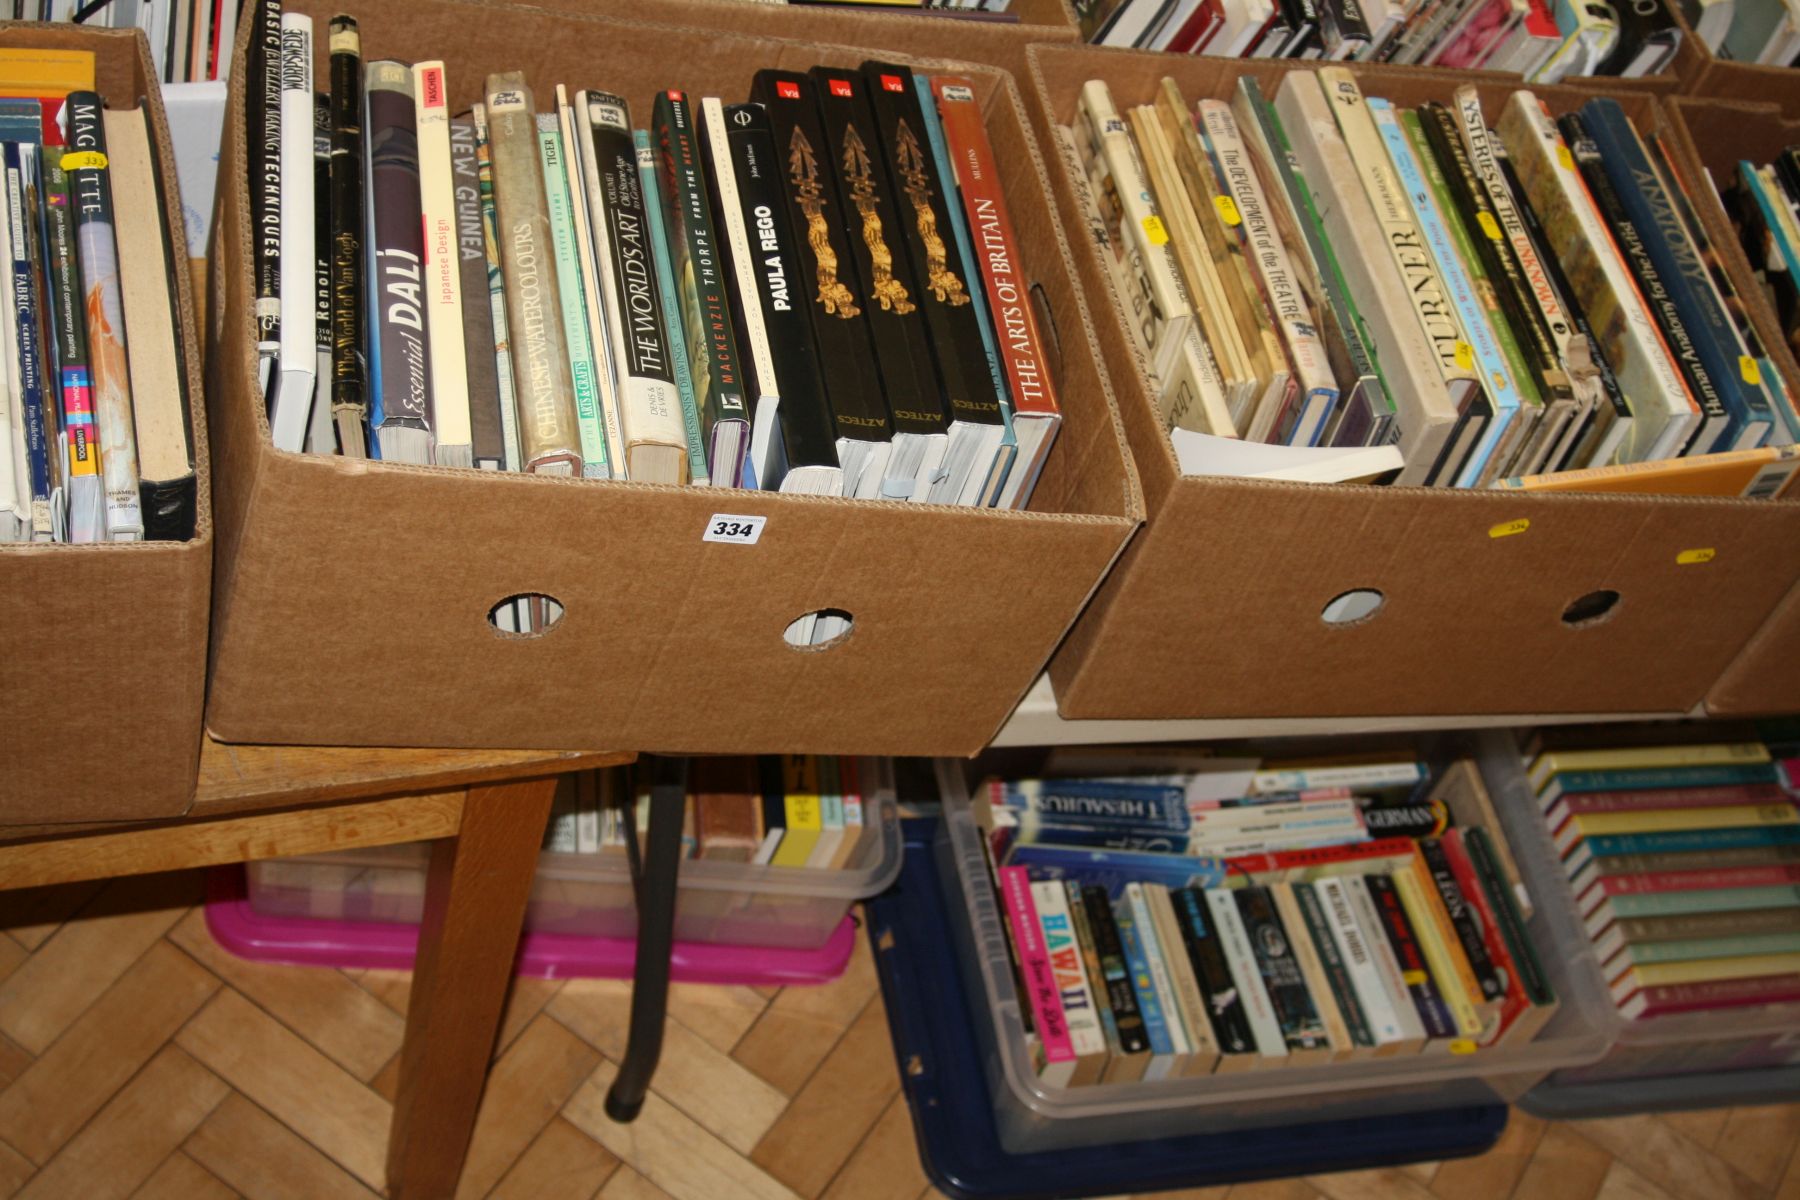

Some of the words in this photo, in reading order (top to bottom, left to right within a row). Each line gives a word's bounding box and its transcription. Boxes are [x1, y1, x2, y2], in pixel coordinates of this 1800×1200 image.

[266, 2, 280, 46] BASIC
[263, 46, 281, 105] JEWELLERY
[283, 28, 303, 91] WORPSWEDE
[428, 71, 437, 104] TASCHEN
[784, 89, 801, 99] RA
[837, 87, 853, 97] RA
[888, 82, 904, 92] RA
[265, 107, 281, 151] MAKING
[672, 101, 684, 129] UNIVERSE
[73, 103, 102, 215] MAGITTE
[451, 125, 476, 177] NEW
[546, 138, 559, 167] TIGER
[616, 155, 627, 171] Age
[679, 134, 692, 165] HEART
[967, 149, 983, 180] MULLINS
[1222, 149, 1238, 168] The
[610, 178, 620, 205] VOLUME
[620, 171, 630, 190] Stone
[685, 170, 696, 188] THE
[264, 154, 281, 257] TECHNIQUES
[553, 193, 564, 221] ADAMS
[622, 190, 632, 208] Old
[691, 192, 703, 219] FROM
[1229, 165, 1272, 240] DEVELOPMENT
[437, 219, 450, 254] Design
[456, 186, 483, 260] GUINEA
[617, 209, 642, 248] ART
[754, 206, 779, 251] REGO
[974, 198, 1013, 274] BRITAIN
[1619, 220, 1647, 259] Artist
[1631, 168, 1710, 285] ANATOMY
[60, 246, 67, 256] 24
[336, 232, 359, 266] Gogh
[557, 228, 570, 261] STEVEN
[695, 229, 715, 285] THORPE
[1259, 239, 1271, 251] of
[1261, 252, 1277, 268] the
[1490, 182, 1508, 202] OF
[1500, 203, 1522, 234] THE
[1513, 236, 1561, 315] UNKNOWN
[61, 256, 71, 284] exhibition
[336, 268, 353, 291] Van
[440, 257, 454, 304] Japanese
[765, 256, 792, 311] PAULA
[1639, 258, 1658, 280] the
[15, 273, 30, 315] FABRIC
[63, 285, 71, 293] of
[316, 259, 329, 321] Renoir
[336, 291, 353, 307] of
[513, 223, 547, 359] WATERCOLOURS
[624, 247, 659, 334] WORLD'S
[995, 277, 1018, 303] OF
[1268, 266, 1300, 324] THEATRE
[1392, 230, 1458, 368] TURNER
[1651, 279, 1668, 300] for
[62, 293, 74, 332] contemporary
[336, 310, 354, 349] World
[22, 323, 32, 351] SCREEN
[67, 333, 76, 359] painting
[707, 295, 734, 384] MACKENZIE
[1002, 307, 1033, 355] ARTS
[1472, 319, 1491, 357] STORIES
[1661, 298, 1697, 364] Anatomy
[24, 352, 34, 389] PRINTING
[337, 349, 356, 376] The
[637, 336, 662, 372] THE
[674, 342, 690, 388] DRAWINGS
[400, 331, 425, 416] Essential
[575, 361, 591, 390] CRAFTS
[1015, 358, 1043, 401] THE
[1691, 362, 1725, 416] Human
[528, 357, 559, 440] CHINESE
[580, 397, 594, 418] ARTS
[895, 410, 942, 421] AZTECS
[953, 399, 1000, 411] AZTECS
[681, 391, 702, 457] IMPRESSIONIST
[837, 415, 885, 427] AZTECS
[77, 430, 85, 460] LIVERPOOL
[713, 522, 754, 537] 334
[1365, 807, 1433, 827] GERMAN
[1041, 913, 1089, 1010] HAWAII
